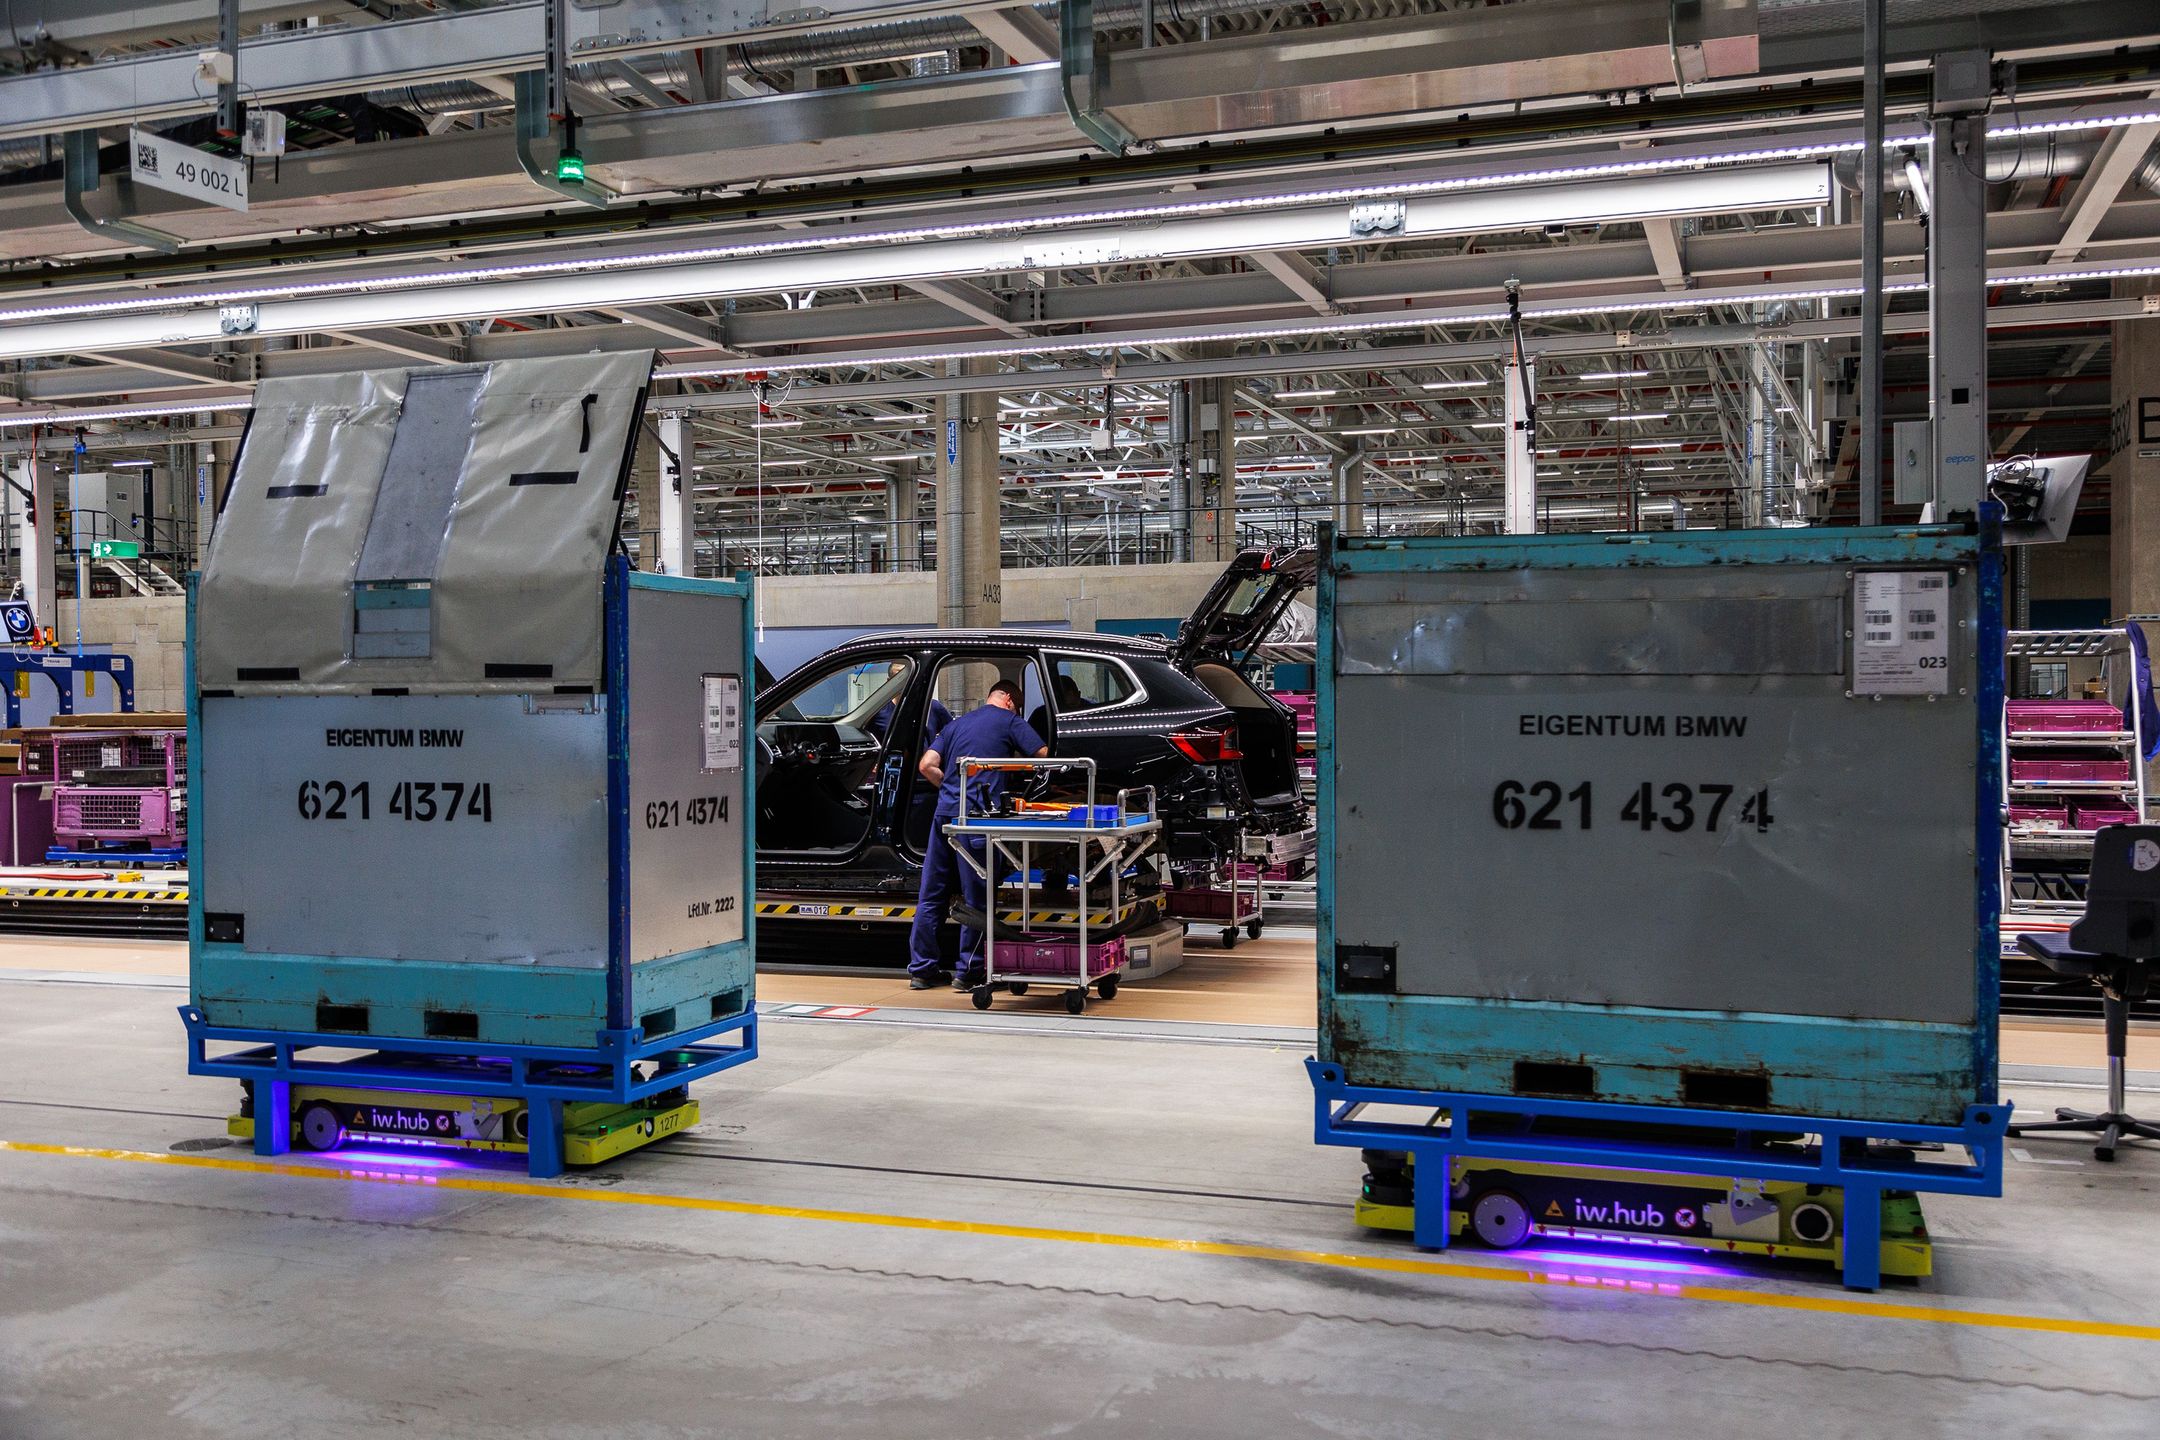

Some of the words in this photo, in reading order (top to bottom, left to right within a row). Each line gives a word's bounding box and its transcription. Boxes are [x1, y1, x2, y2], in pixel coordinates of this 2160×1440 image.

[176, 162, 196, 182] 49
[201, 168, 230, 193] 002
[235, 178, 244, 197] L
[1945, 454, 1975, 465] eepos
[983, 584, 1001, 604] AA33
[1919, 657, 1947, 669] 023
[1519, 714, 1665, 737] EIGENTUM
[1675, 716, 1747, 737] BMW
[326, 729, 414, 748] EIGENTUM
[419, 729, 464, 748] BMW
[298, 780, 370, 820] 621
[389, 781, 492, 822] 4374
[1492, 780, 1592, 830] 621
[1620, 781, 1774, 833] 4374
[646, 800, 679, 830] 621
[686, 796, 729, 825] 4374
[715, 897, 734, 914] 2222
[813, 905, 828, 915] 012
[372, 1108, 430, 1131] iw.hub
[661, 1113, 679, 1132] 1277
[1575, 1198, 1664, 1227] iw.hub
